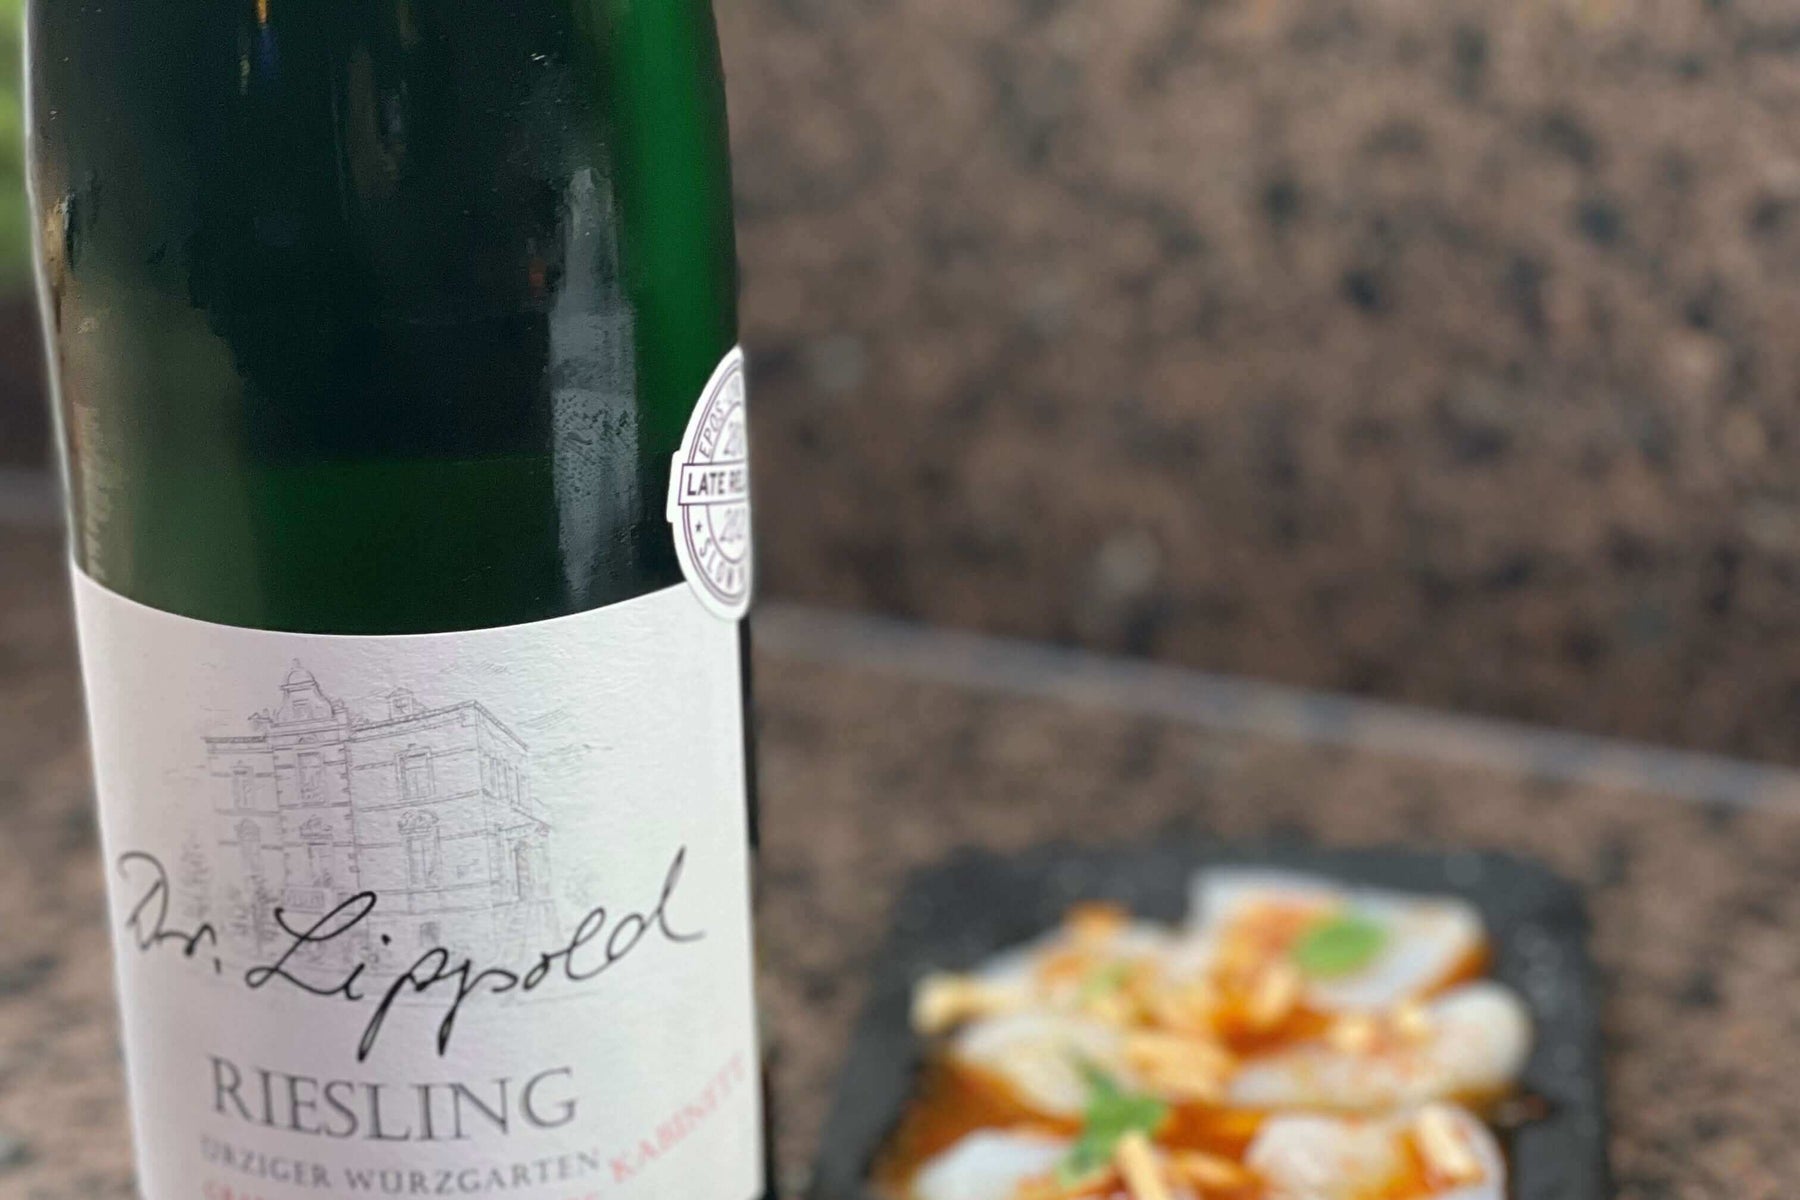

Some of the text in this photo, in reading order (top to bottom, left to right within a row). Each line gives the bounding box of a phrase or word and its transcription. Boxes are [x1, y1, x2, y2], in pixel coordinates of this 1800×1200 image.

[687, 471, 725, 495] LATE
[118, 846, 705, 1062] Dr. Lippold
[207, 1054, 576, 1141] RIESLING
